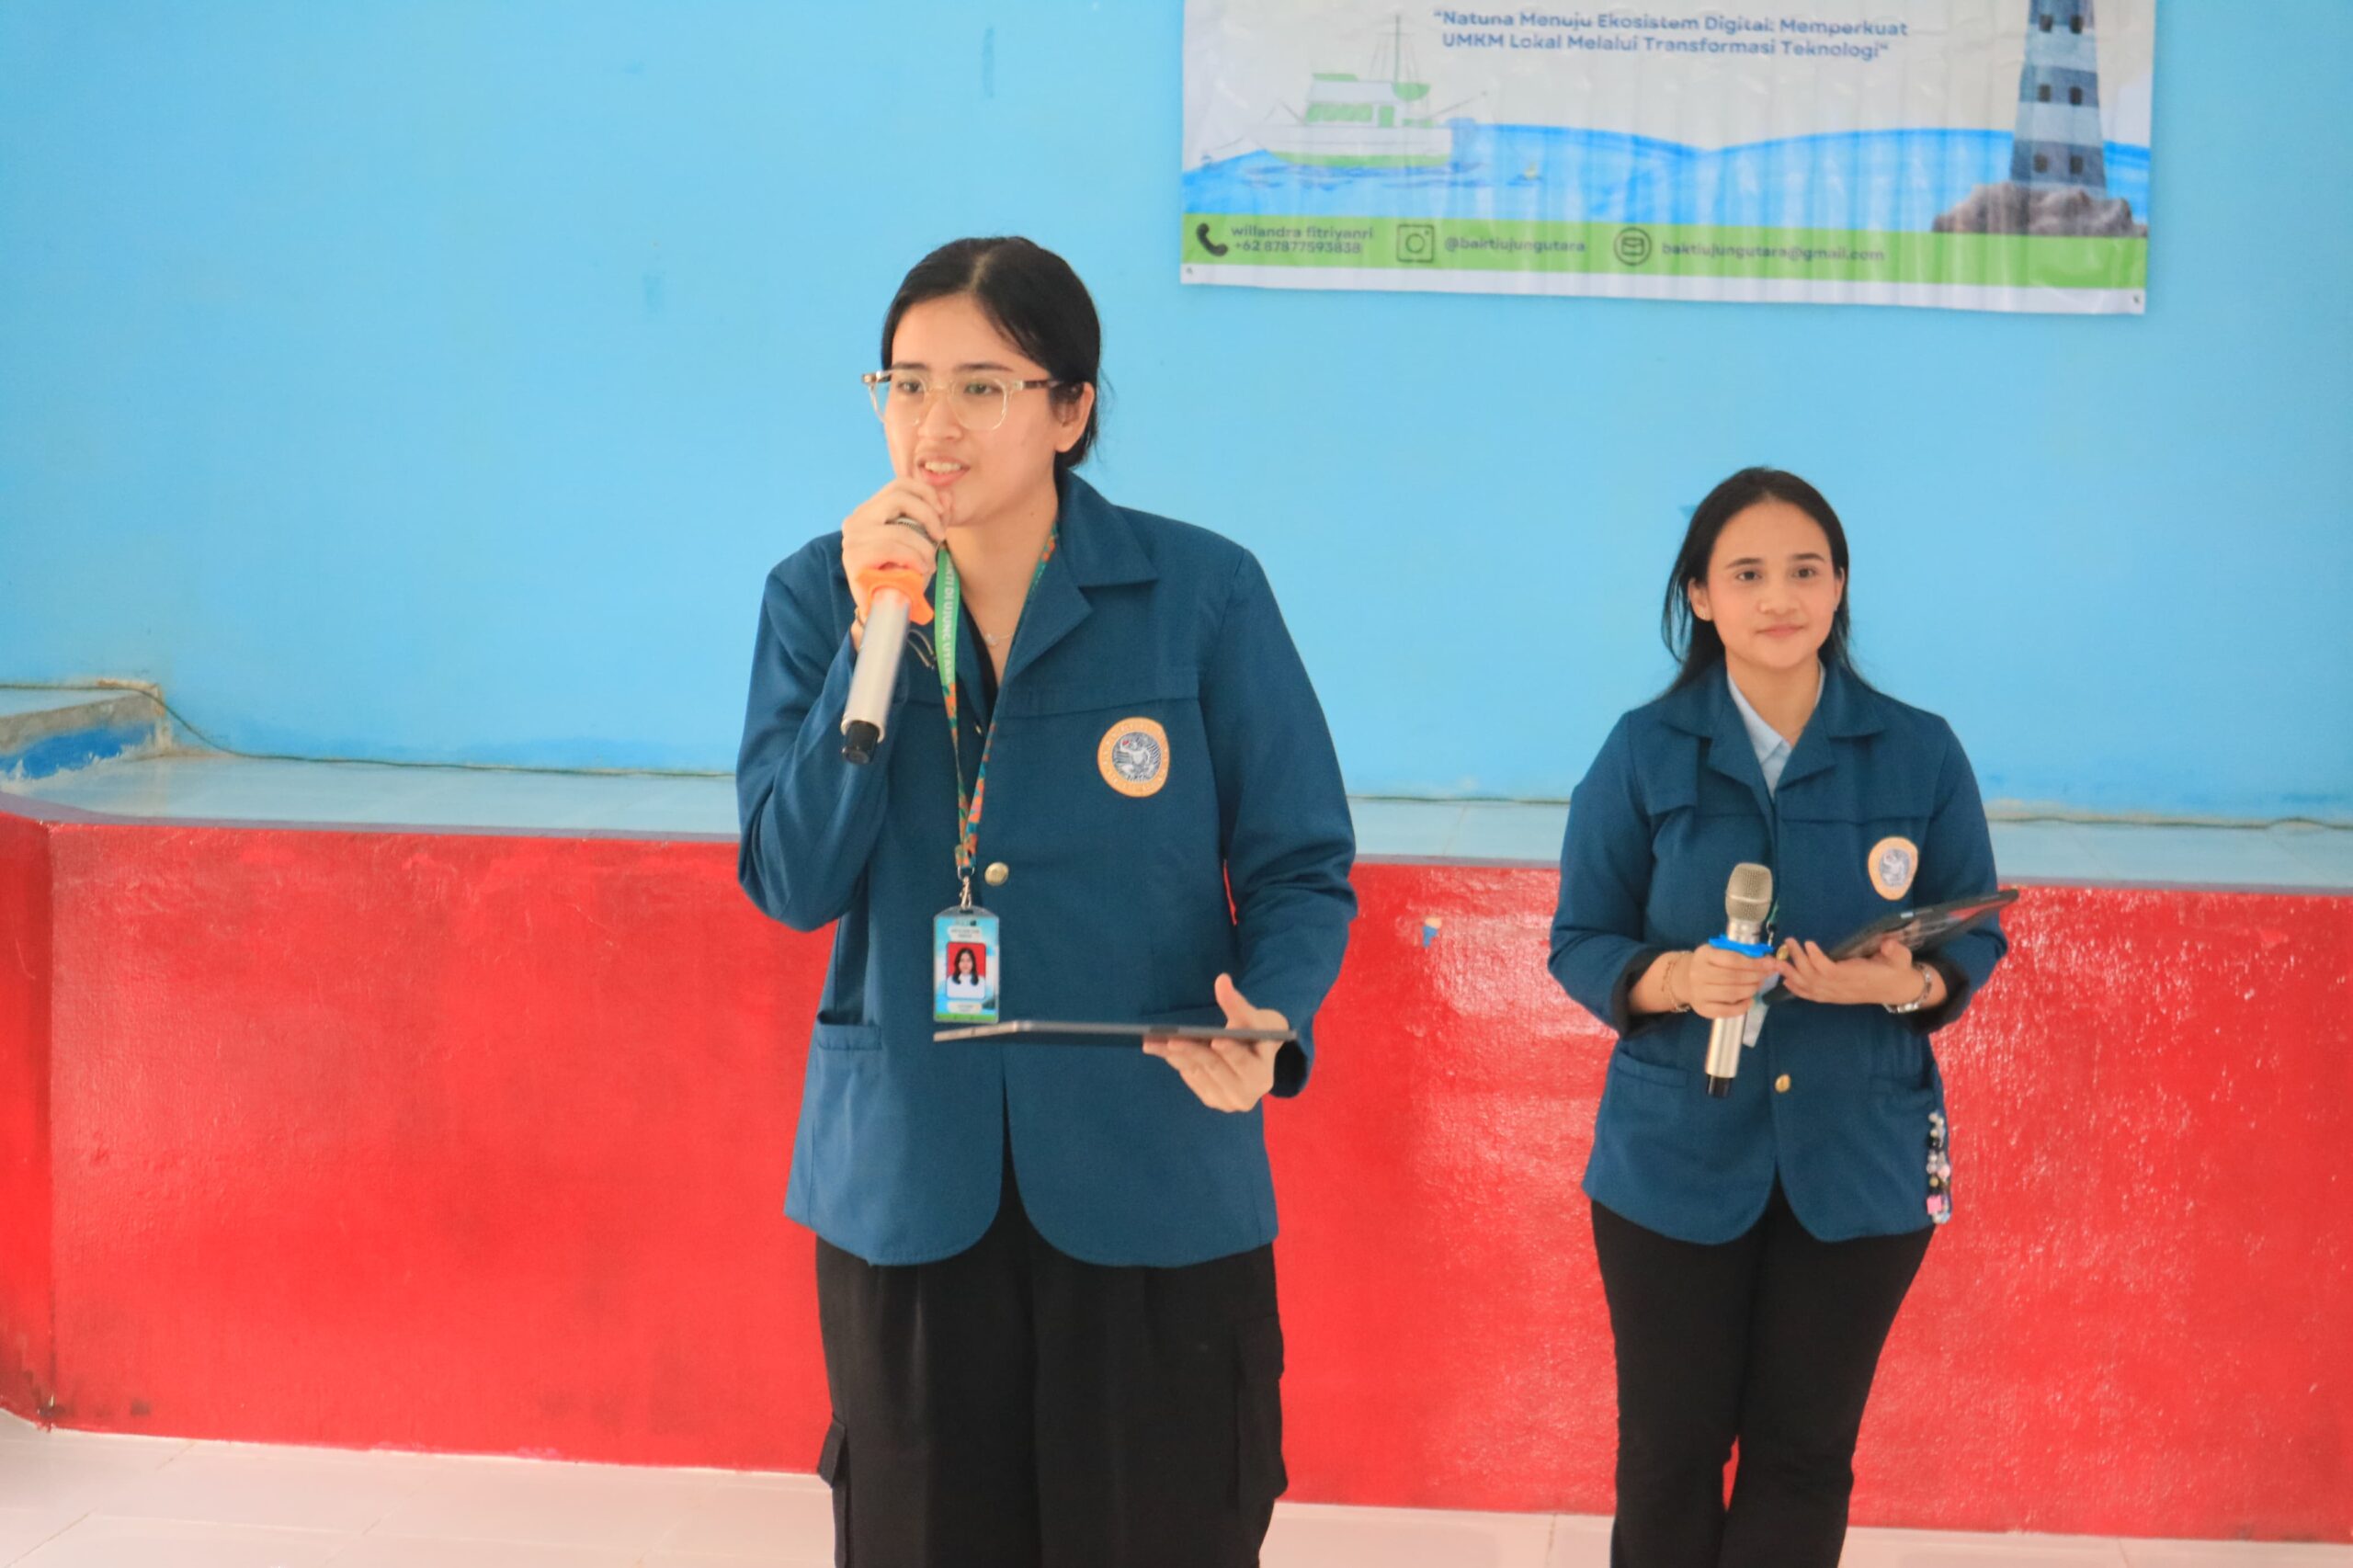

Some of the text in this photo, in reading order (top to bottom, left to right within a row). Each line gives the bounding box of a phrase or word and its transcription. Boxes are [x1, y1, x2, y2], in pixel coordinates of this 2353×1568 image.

[1519, 12, 1592, 30] Menuju
[1597, 14, 1699, 29] Ekosistem
[1780, 18, 1908, 37] Memperkuat
[1442, 33, 1505, 47] UMKM
[1510, 34, 1562, 49] Lokal
[1567, 35, 1638, 51] Melalui
[1644, 37, 1775, 54] Transformasi
[1235, 239, 1260, 252] +62
